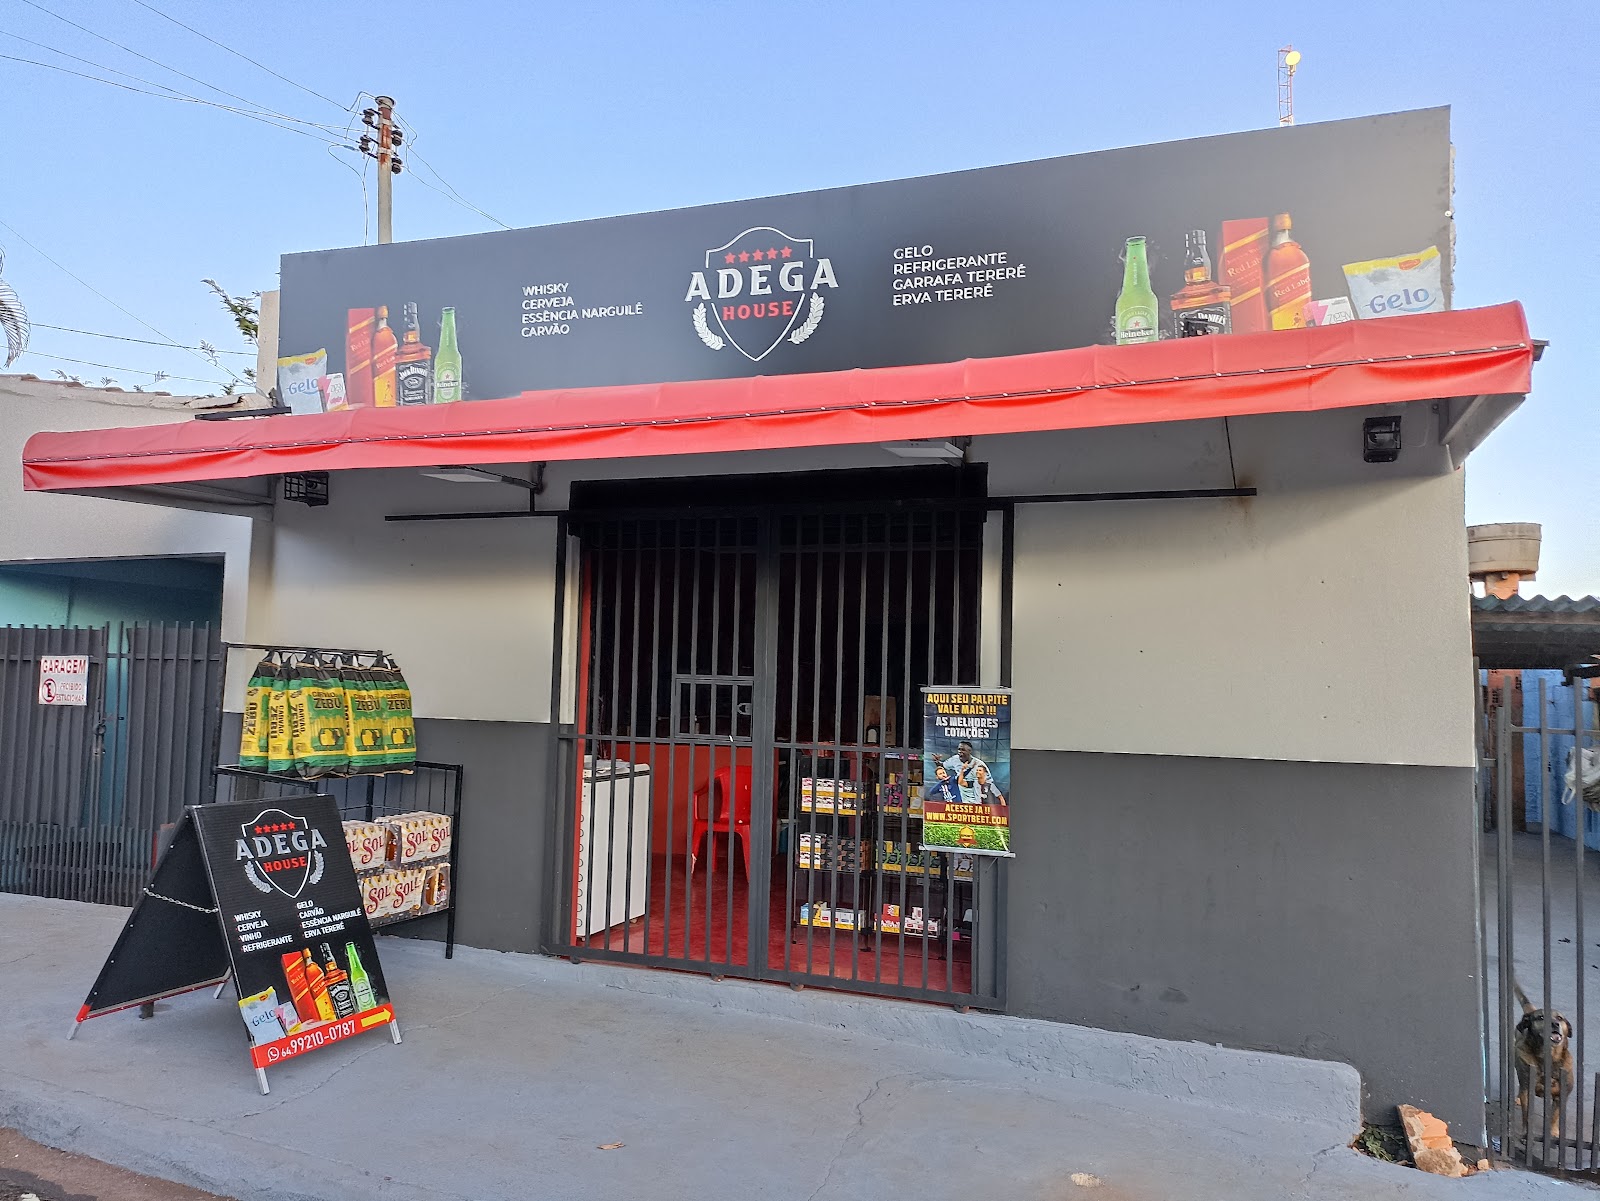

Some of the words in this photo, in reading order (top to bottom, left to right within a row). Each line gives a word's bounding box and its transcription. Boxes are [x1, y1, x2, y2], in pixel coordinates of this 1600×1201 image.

[893, 245, 934, 259] GELO
[893, 252, 1008, 275] REFRIGERANTE
[684, 258, 839, 302] ADEGA
[892, 273, 964, 291] GARRAFA
[966, 264, 1027, 283] TERERÉ
[522, 283, 569, 296] WHISKY
[892, 292, 933, 306] ERVA
[935, 283, 994, 302] TERERÉ
[521, 296, 575, 310] CERVEJA
[1367, 288, 1431, 314] Gelo
[521, 310, 579, 324] ESSÊNCIA
[722, 300, 794, 321] HOUSE
[521, 323, 570, 338] CARVÃO
[288, 378, 319, 394] Gelo
[43, 659, 86, 673] GARAGEM
[927, 693, 949, 704] AQUI
[951, 693, 969, 704] SEU
[971, 694, 1008, 705] PALPITE
[937, 704, 960, 714] VALE
[961, 705, 984, 715] MAIS
[986, 705, 997, 715] !!!
[935, 716, 948, 726] AS
[949, 717, 999, 728] MELHORES
[944, 727, 990, 739] COTAÇÕES
[945, 804, 973, 813] ACESSE
[926, 811, 1008, 825] WWW.SPORTBEET.COM
[236, 829, 327, 860] ADEGA
[405, 830, 428, 858] SOL
[431, 826, 450, 853] SOL
[361, 836, 384, 865] SOL
[263, 856, 307, 872] HOUSE
[297, 900, 314, 909] GELO
[366, 885, 391, 914] SOL
[234, 911, 261, 922] WHISKY
[299, 907, 324, 919] CARVÃO
[237, 920, 269, 932] CERVEJA
[302, 916, 332, 928] ESSÊNCIA
[240, 931, 262, 942] VINHO
[304, 929, 321, 939] ERVA
[321, 921, 345, 934] TERERÉ
[243, 935, 293, 953] REFRIGERANTE
[252, 1010, 276, 1027] Gelo
